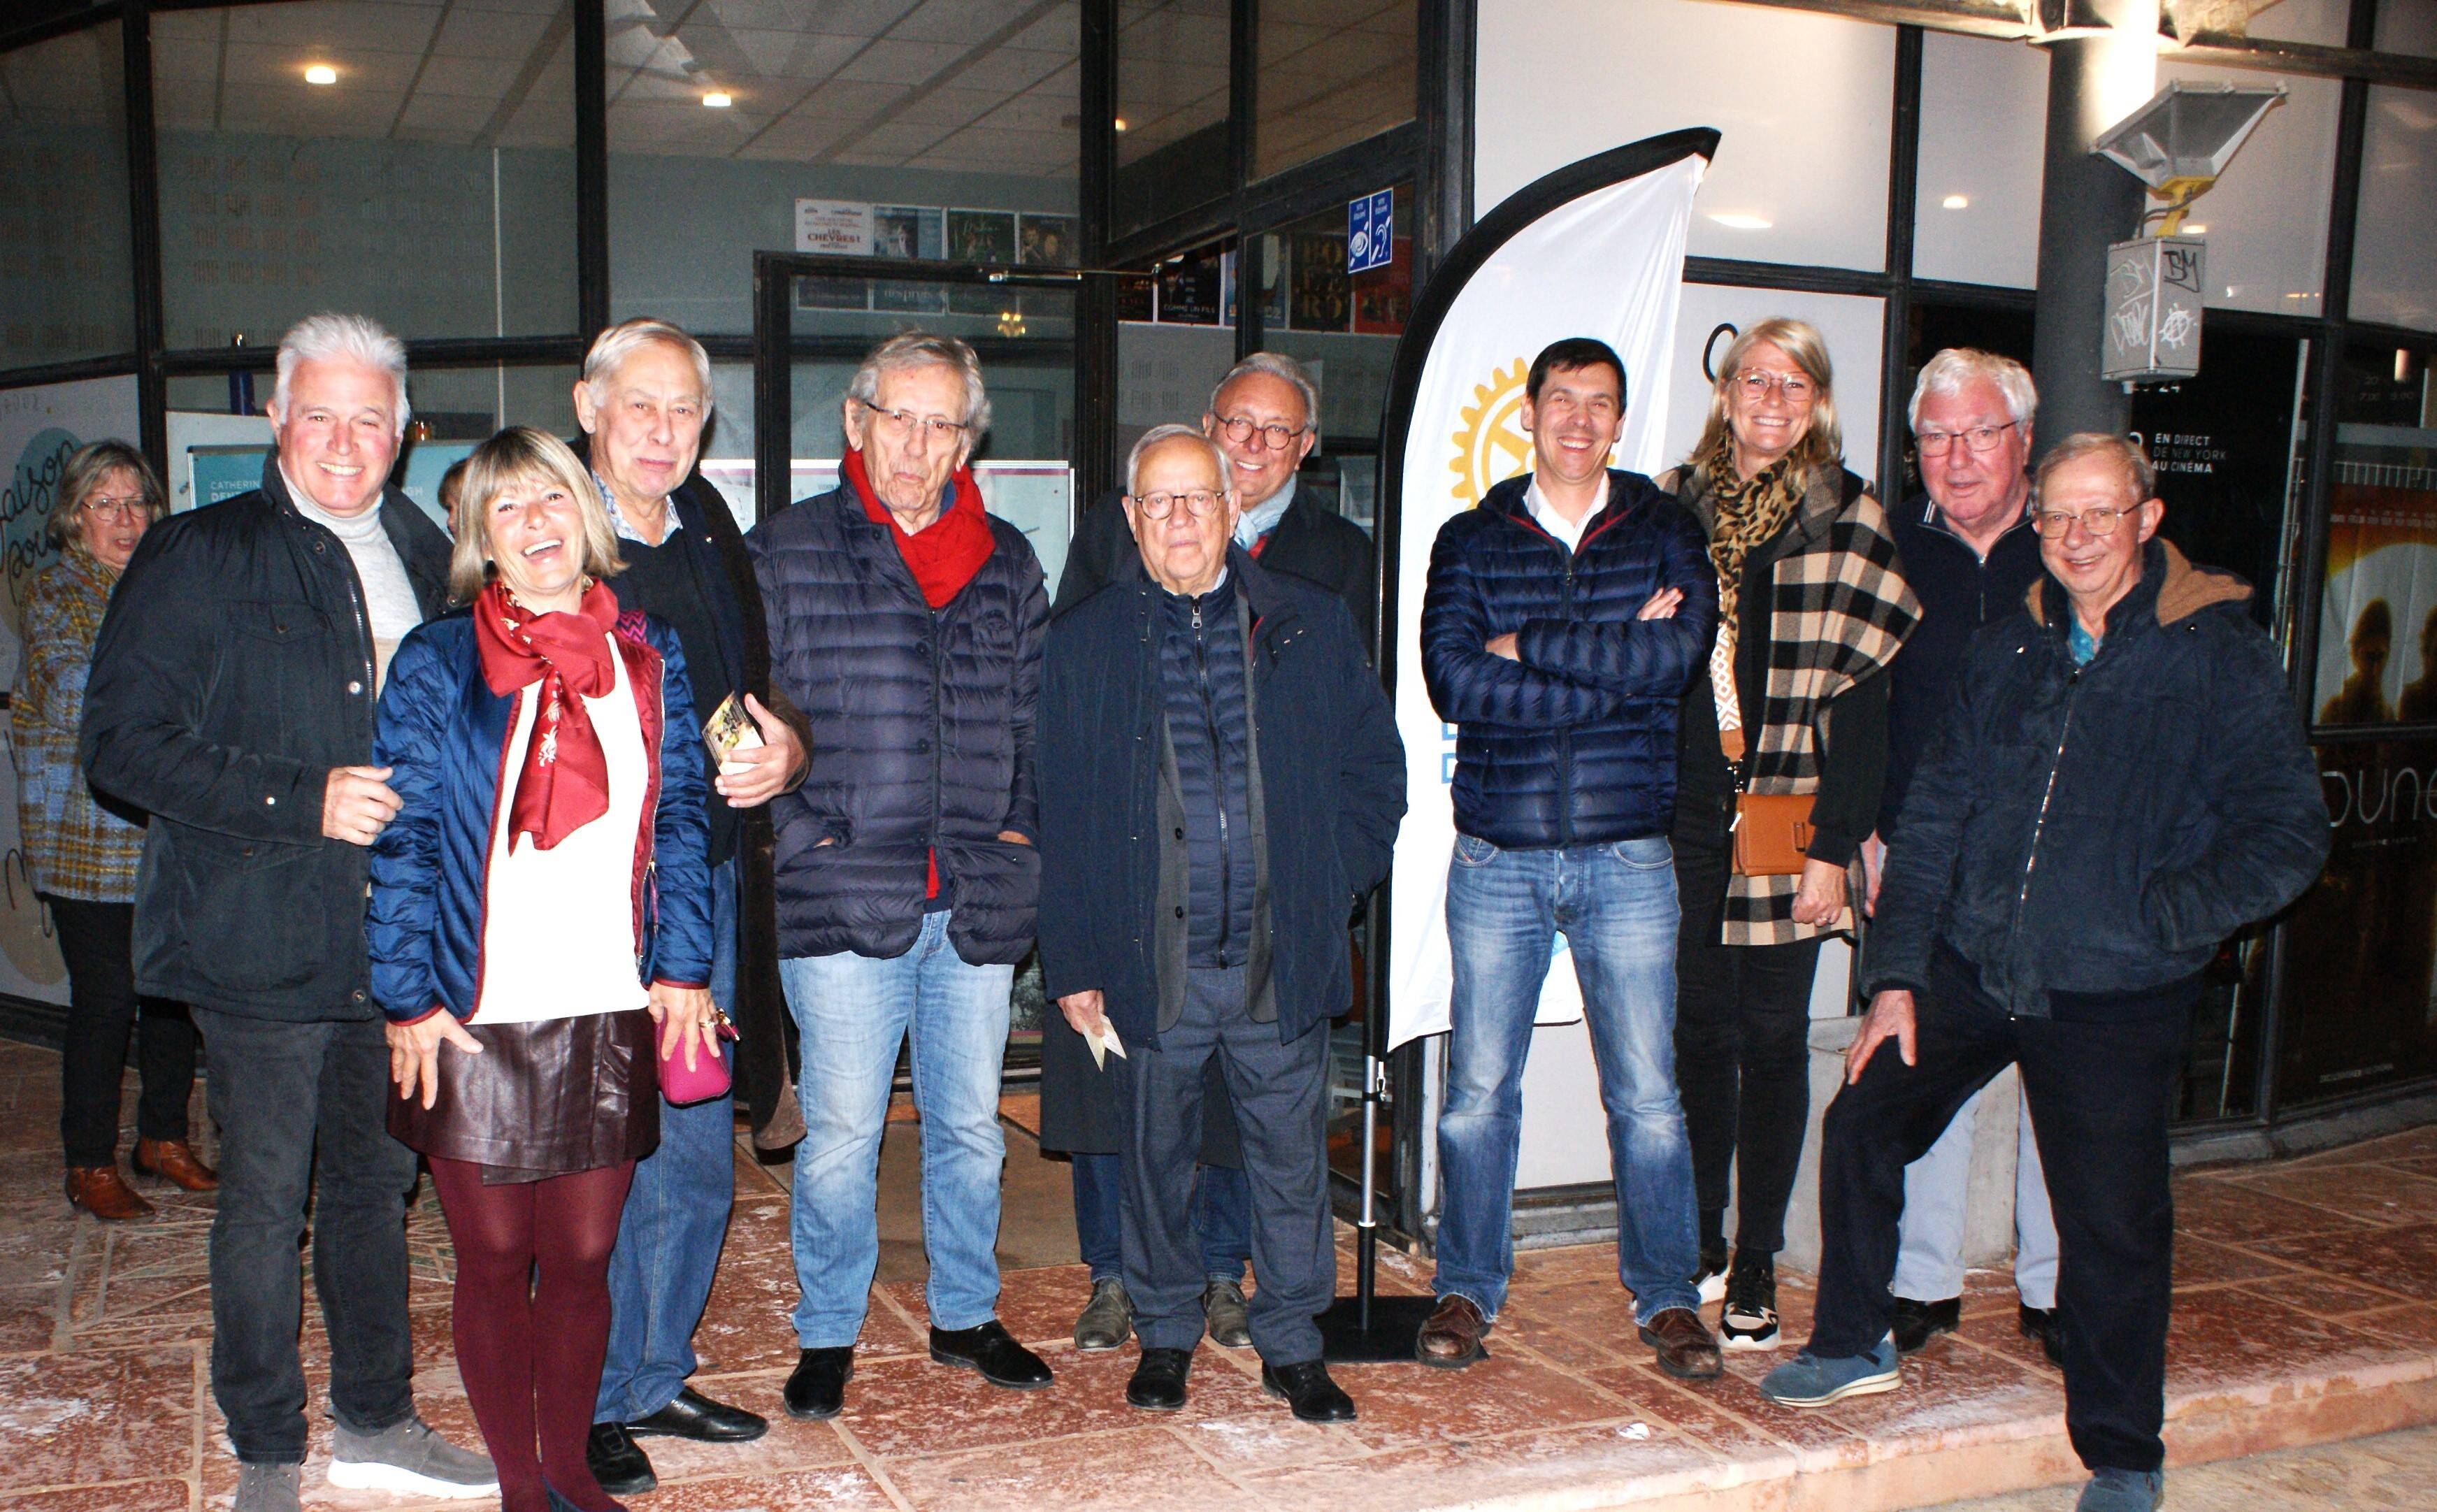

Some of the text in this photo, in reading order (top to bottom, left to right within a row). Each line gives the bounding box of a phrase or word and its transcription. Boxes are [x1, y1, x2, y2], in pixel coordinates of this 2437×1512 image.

[2155, 433, 2211, 446] EN DIRECT
[2152, 446, 2227, 461] DE NEW YORK
[2151, 459, 2213, 474] AU CINÉMA
